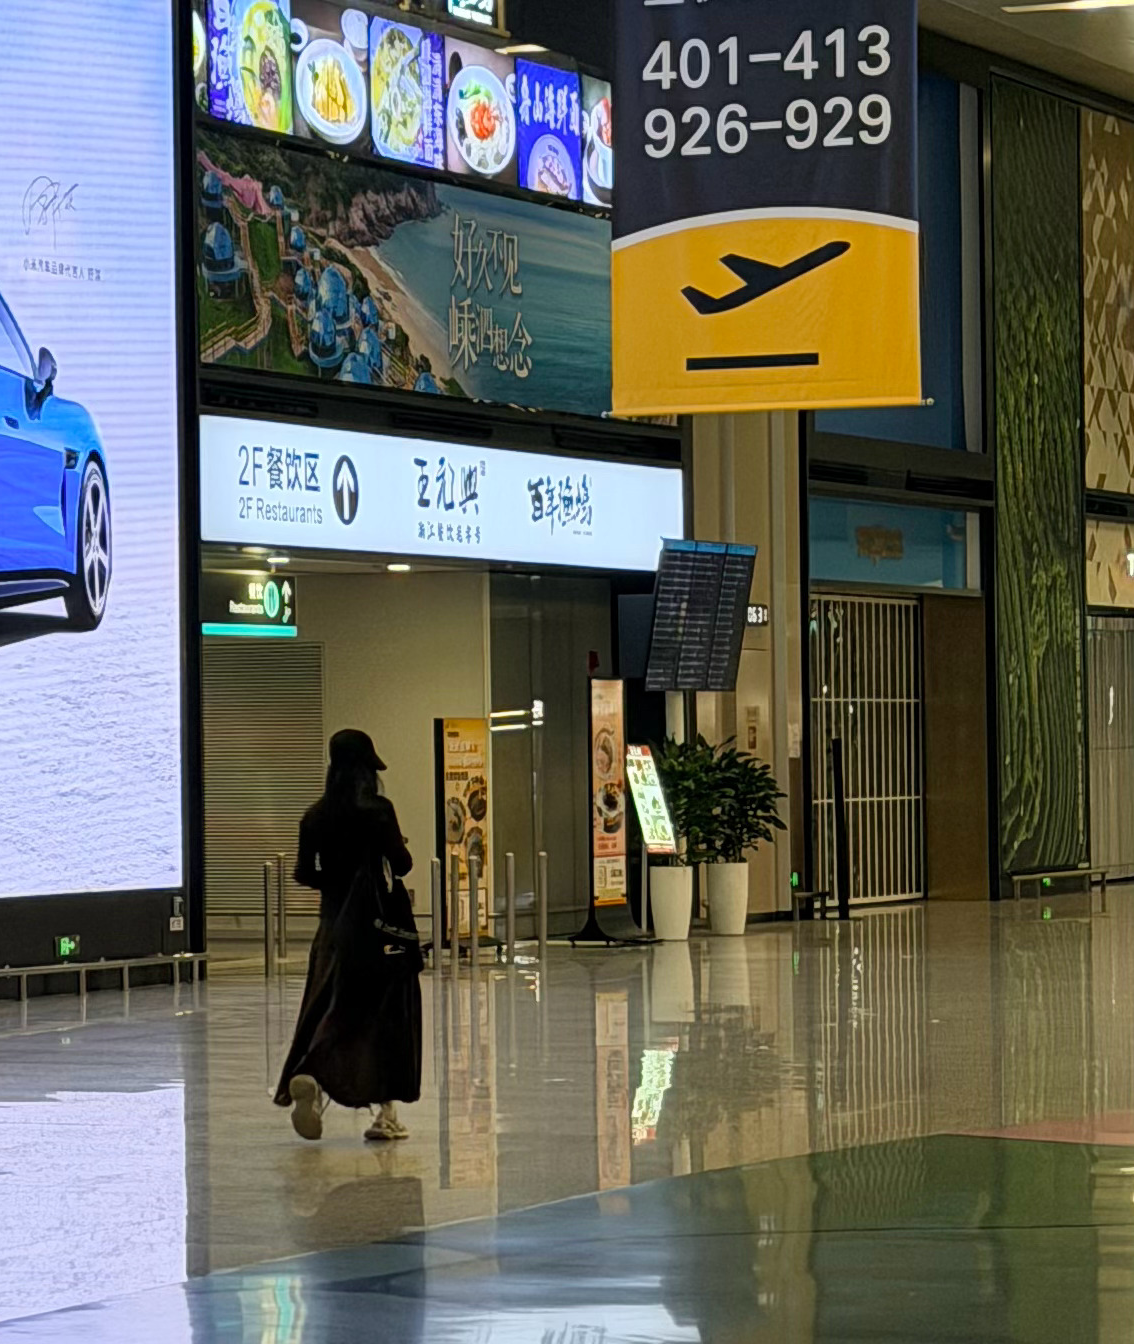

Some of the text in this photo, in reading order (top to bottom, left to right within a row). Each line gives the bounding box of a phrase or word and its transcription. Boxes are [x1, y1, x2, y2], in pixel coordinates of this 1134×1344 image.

[642, 24, 892, 91] 401-413
[643, 93, 893, 160] 926-929
[450, 212, 523, 297] 好久不见
[238, 496, 323, 525] 2F Restaurants
